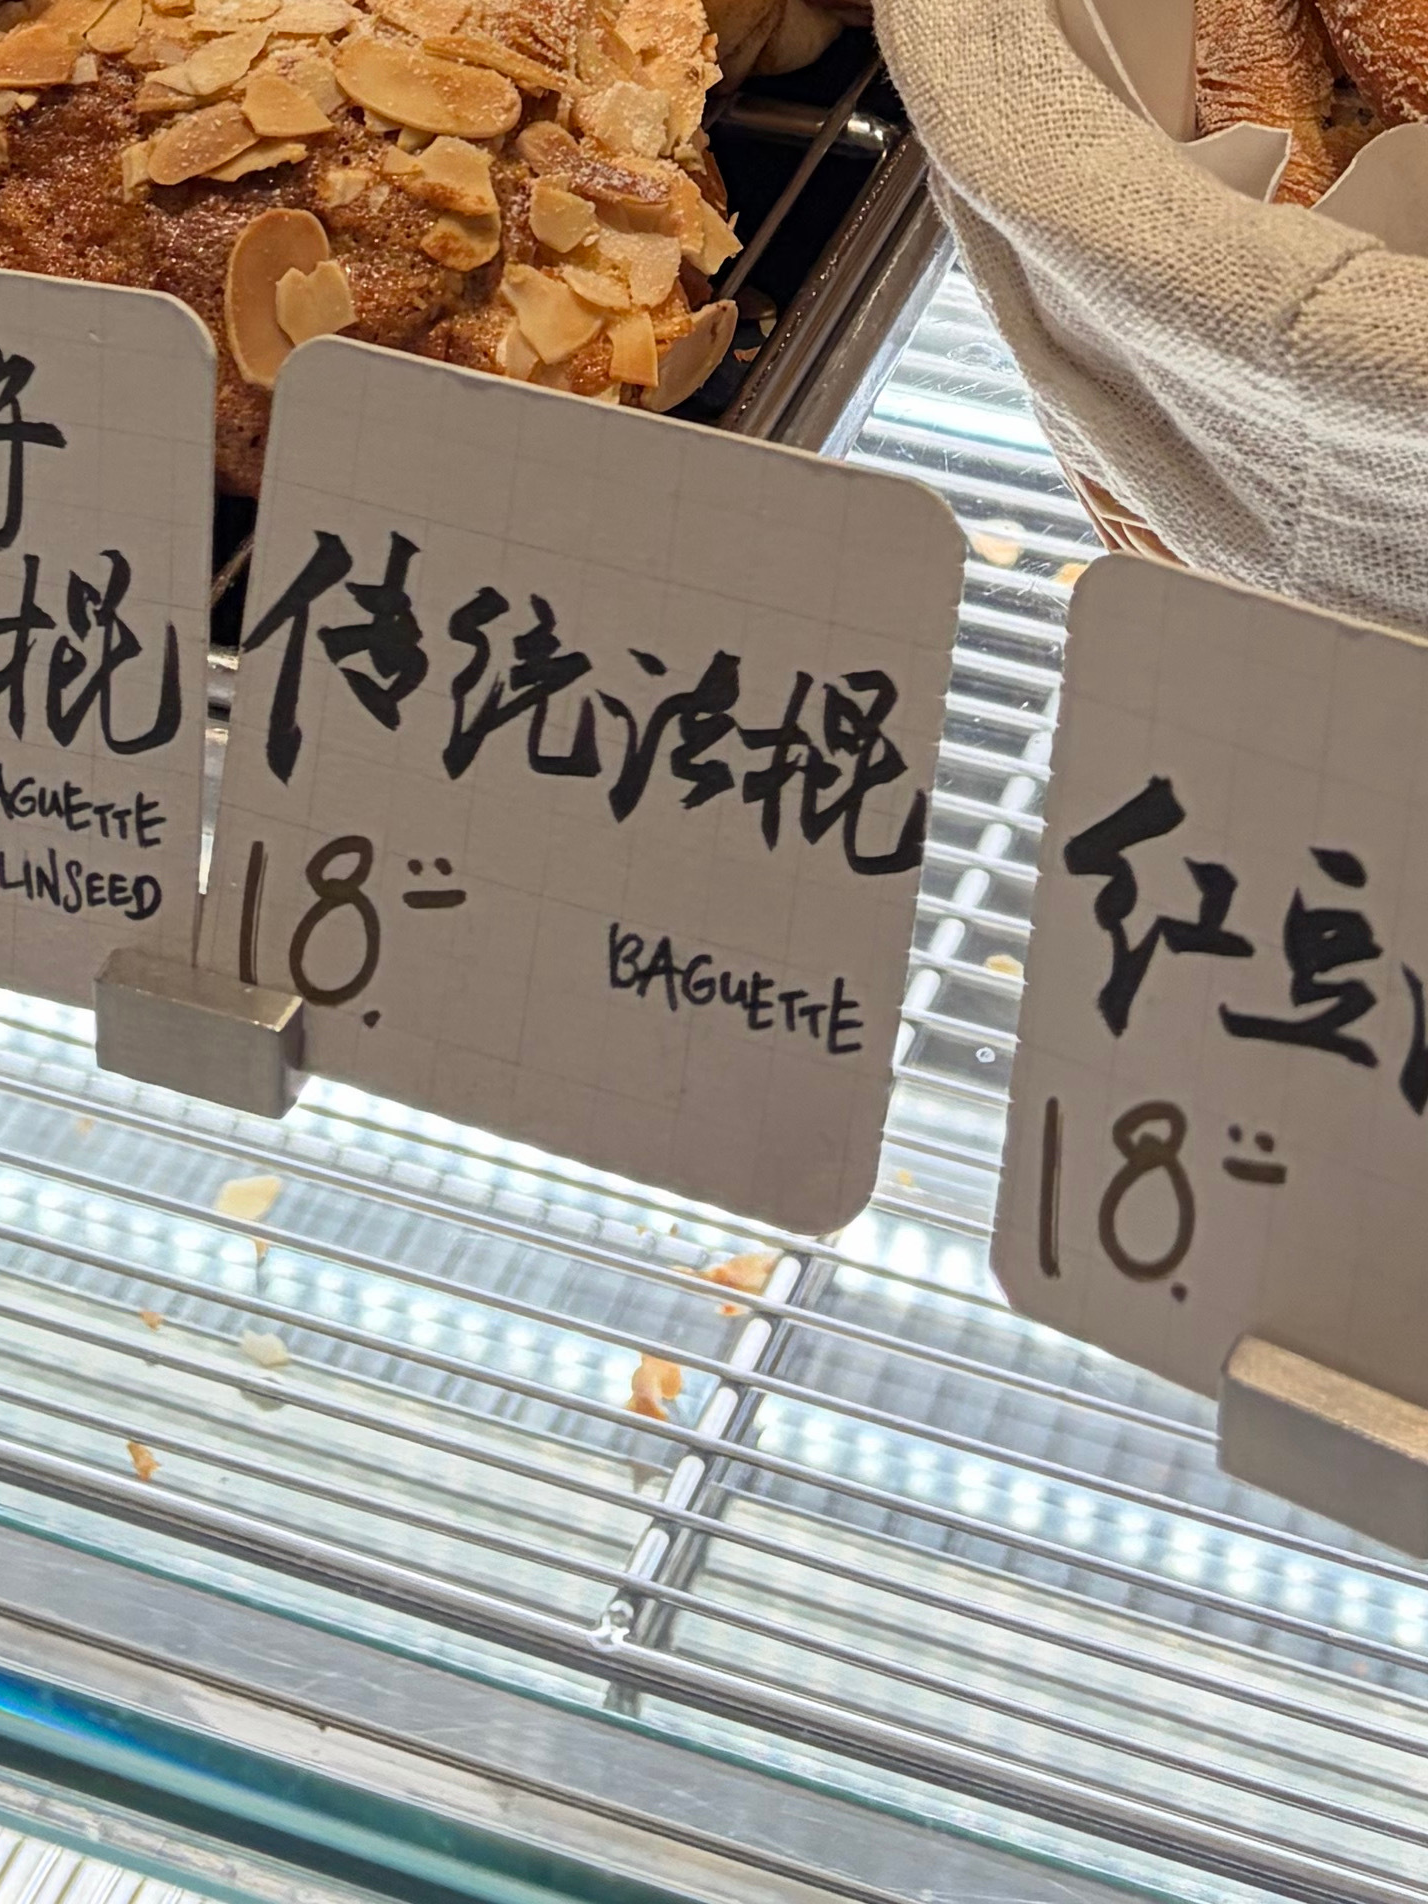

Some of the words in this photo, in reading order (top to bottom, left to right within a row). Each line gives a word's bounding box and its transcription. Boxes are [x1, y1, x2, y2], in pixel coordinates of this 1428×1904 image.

[241, 529, 927, 877] 传统法棍
[608, 922, 864, 1054] BAGUETTE
